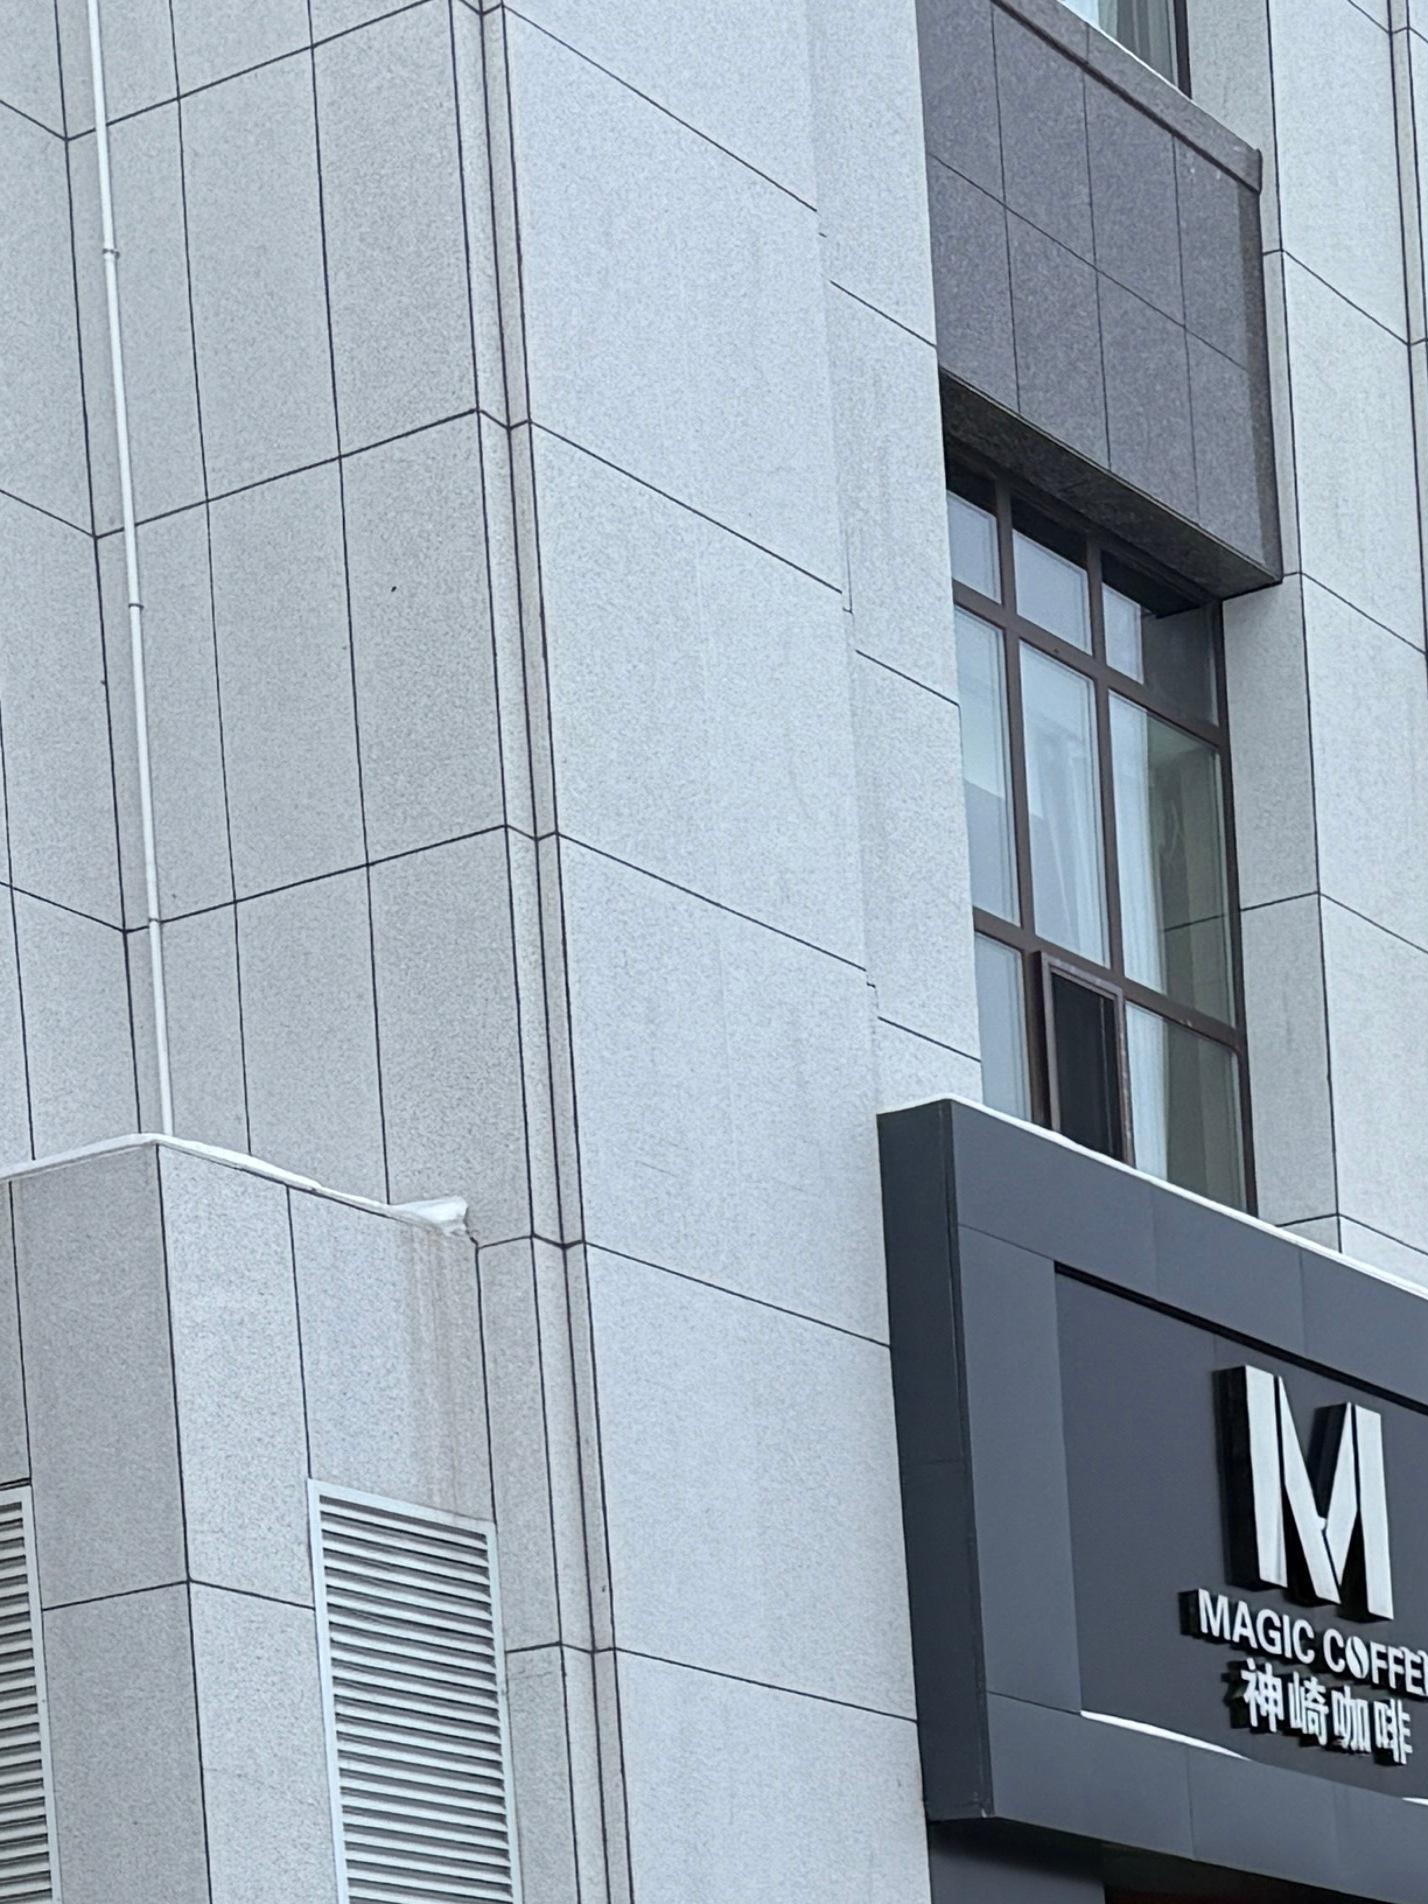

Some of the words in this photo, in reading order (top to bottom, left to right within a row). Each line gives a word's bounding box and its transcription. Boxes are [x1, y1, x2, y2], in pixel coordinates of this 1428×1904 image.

[1232, 1364, 1395, 1620] M
[1196, 1589, 1316, 1663] MAGIC
[1240, 1658, 1414, 1764] 神崎咖啡
